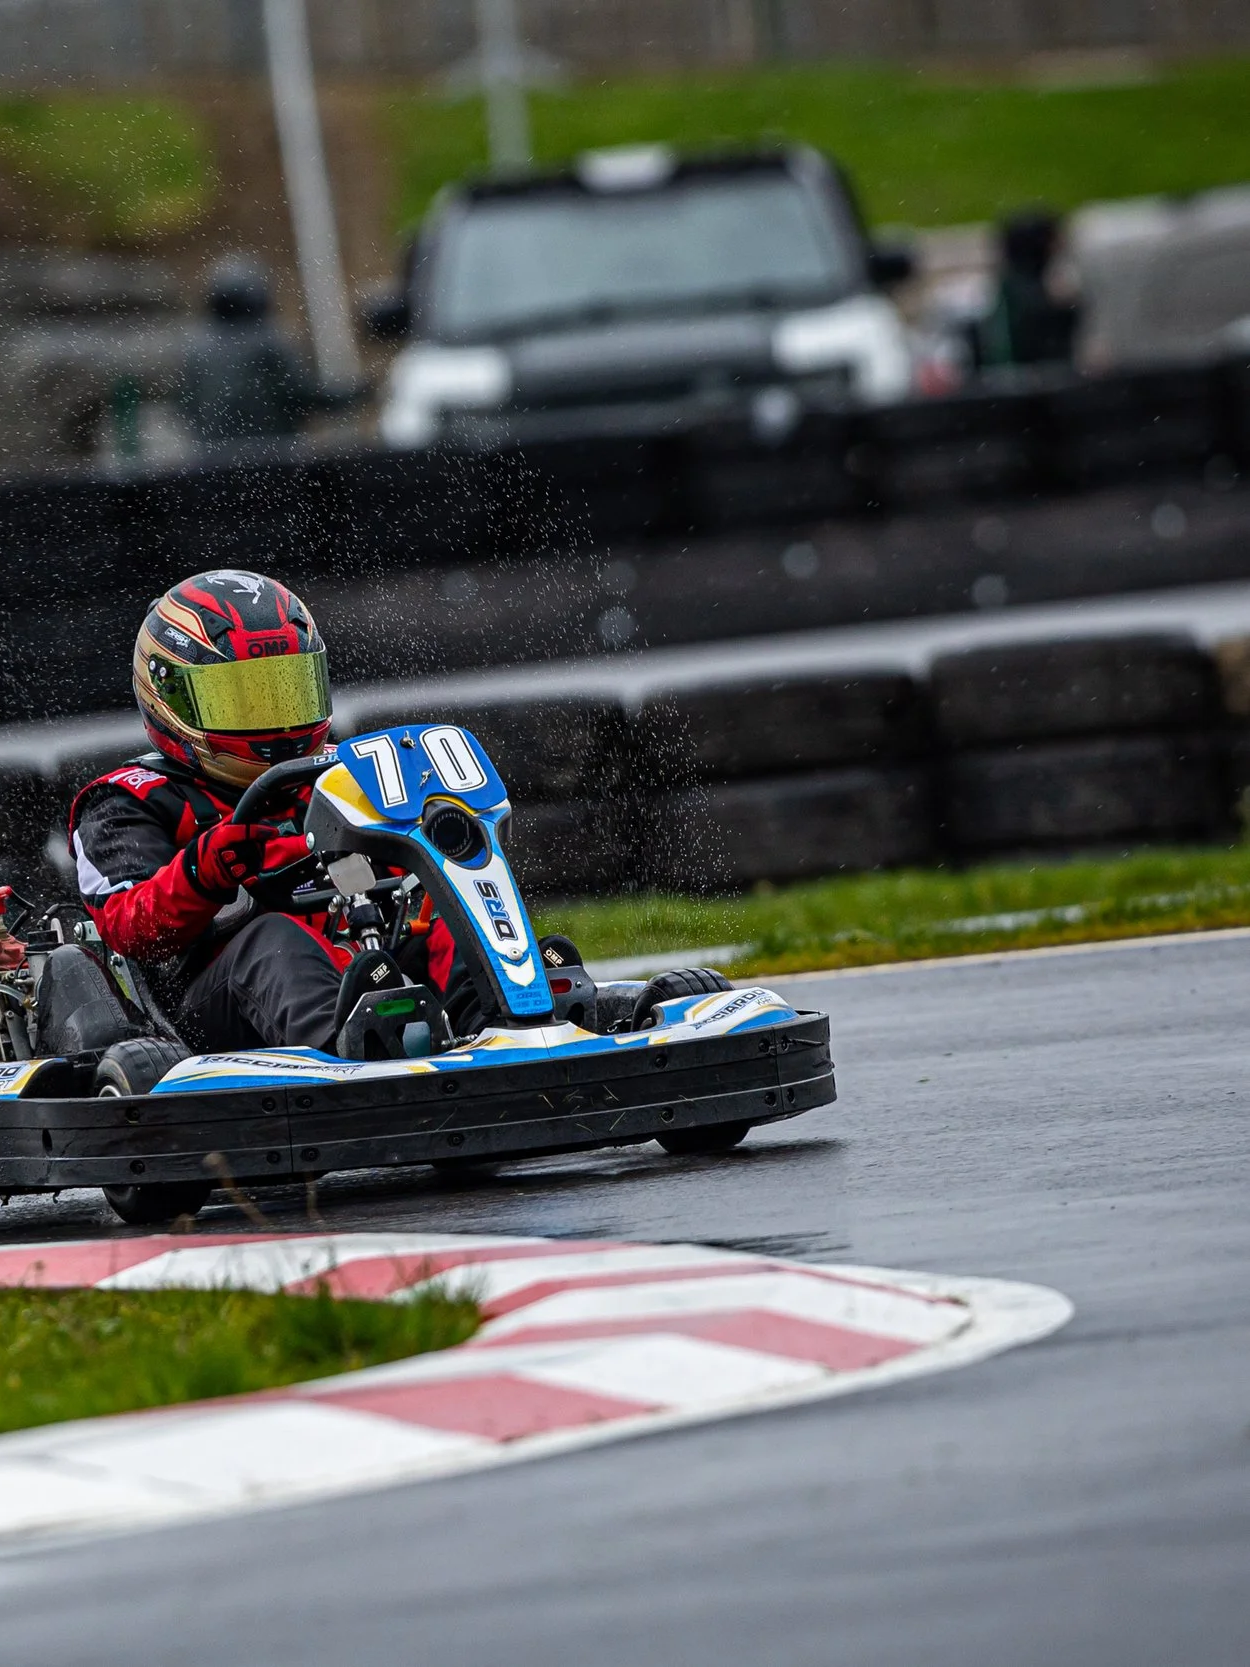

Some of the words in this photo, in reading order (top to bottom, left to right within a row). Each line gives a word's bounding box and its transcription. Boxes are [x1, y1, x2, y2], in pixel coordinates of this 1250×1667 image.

[248, 640, 289, 657] OMP
[314, 754, 340, 765] DR
[350, 724, 489, 809] 70
[474, 880, 517, 940] DRS
[546, 949, 563, 965] OMP
[373, 965, 388, 981] OMP
